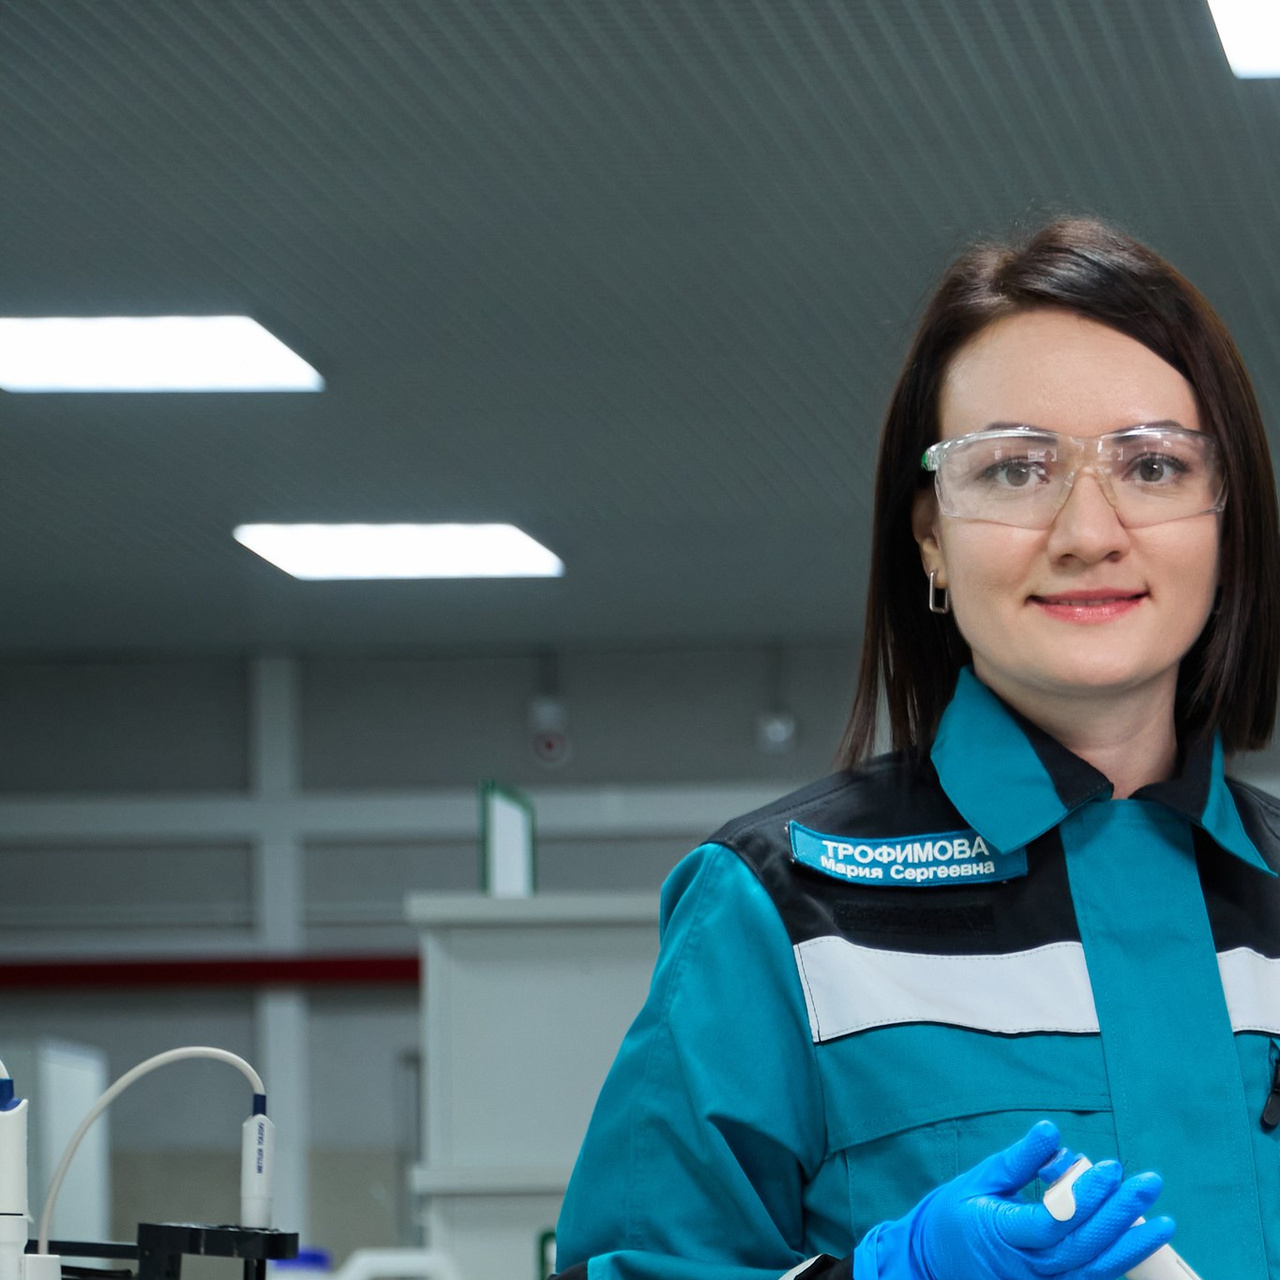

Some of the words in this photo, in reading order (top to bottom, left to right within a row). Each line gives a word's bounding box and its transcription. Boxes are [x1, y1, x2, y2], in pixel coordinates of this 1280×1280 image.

[821, 836, 990, 864] ТРОФИМОВА
[820, 856, 883, 879] Мария
[890, 861, 995, 882] Сергеевна
